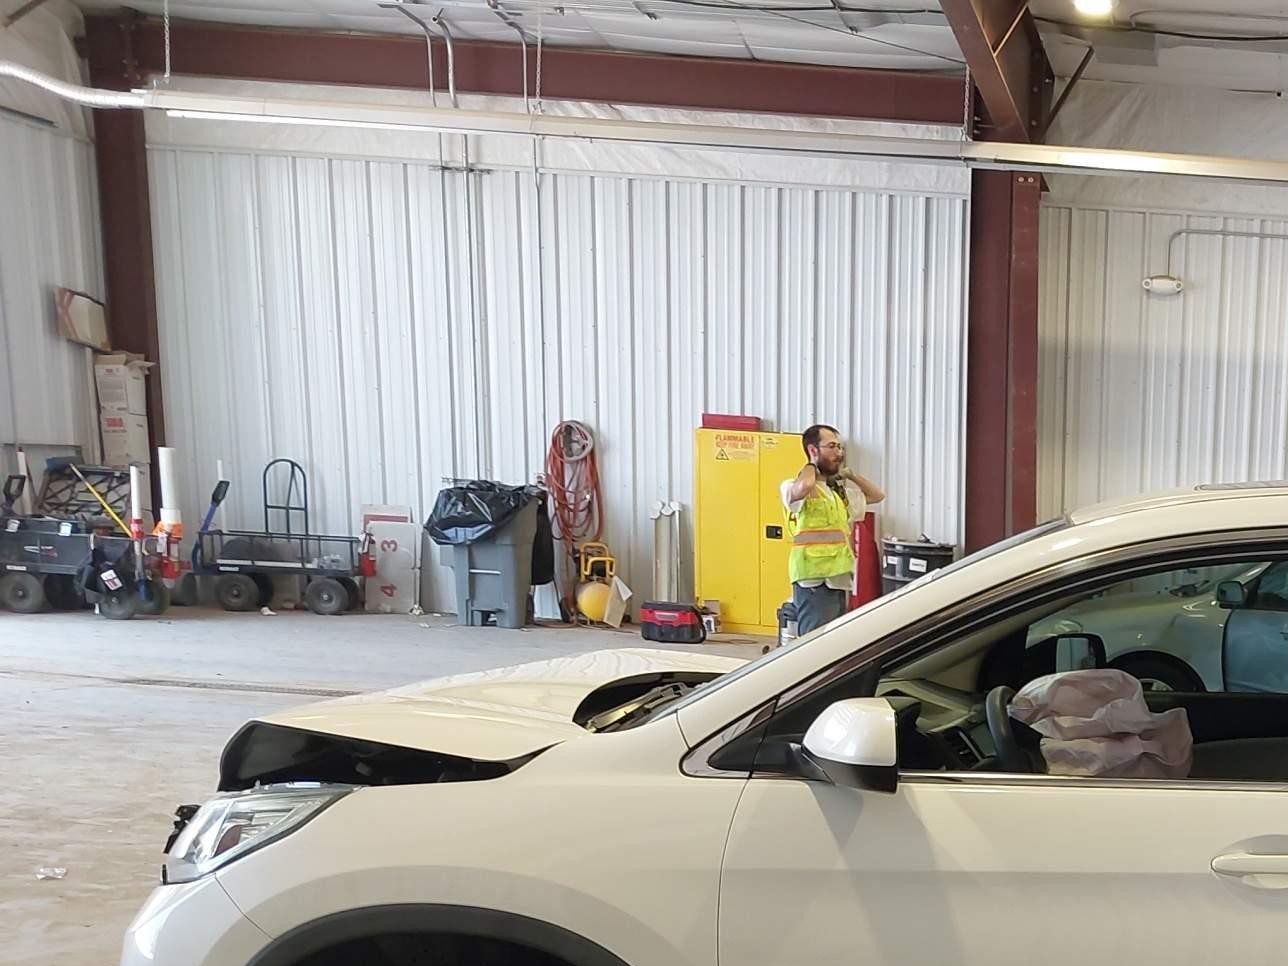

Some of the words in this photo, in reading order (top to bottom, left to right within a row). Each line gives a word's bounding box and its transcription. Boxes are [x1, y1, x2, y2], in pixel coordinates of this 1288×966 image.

[715, 434, 754, 443] FLAMMABLE
[380, 539, 398, 552] 3
[380, 583, 397, 597] 4
